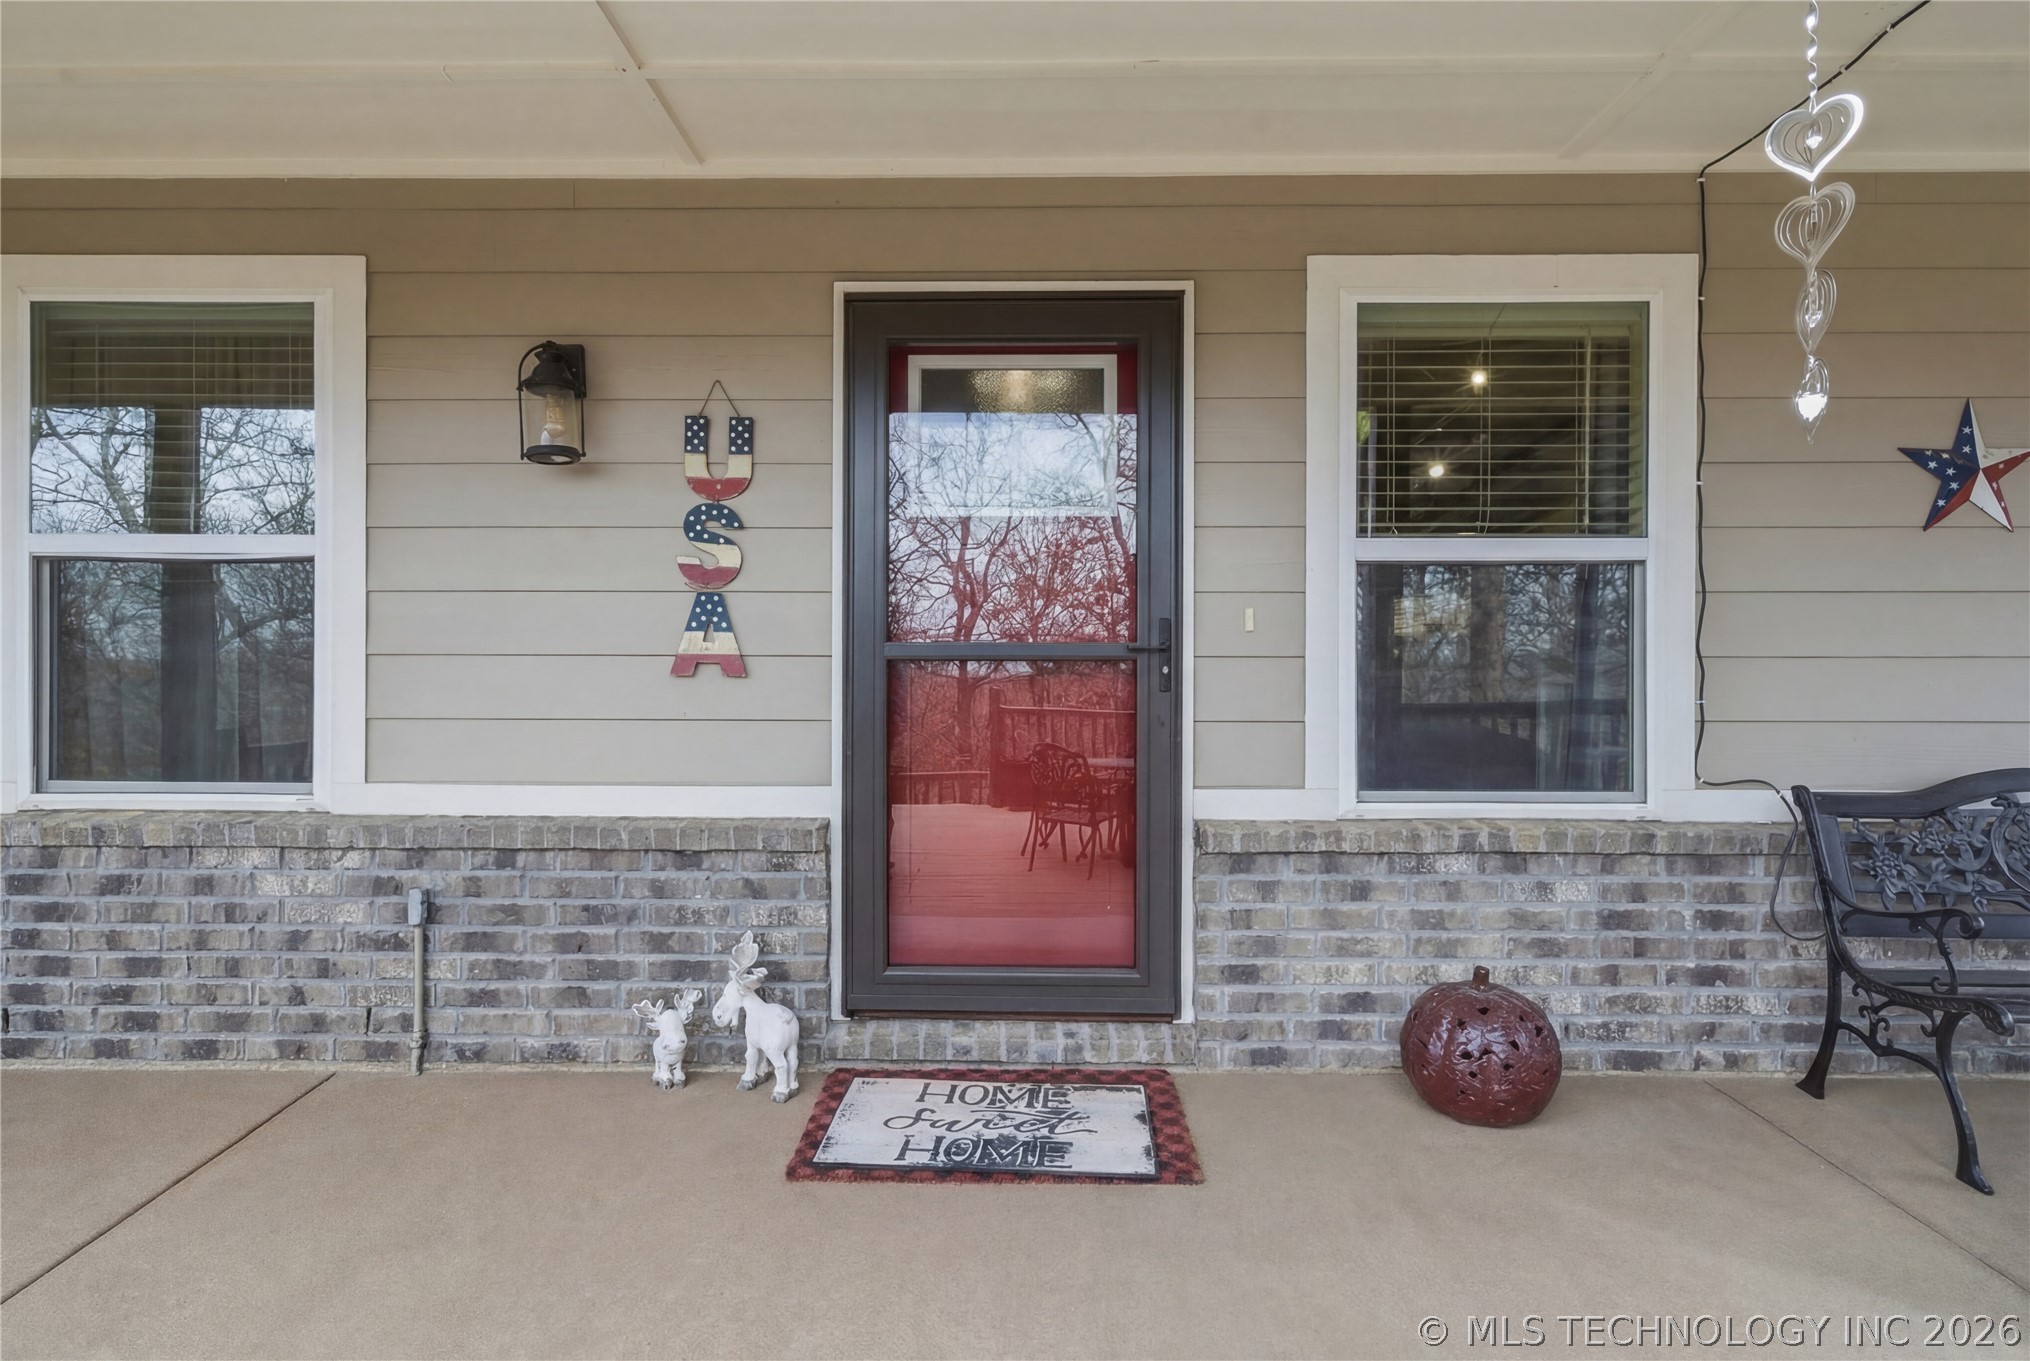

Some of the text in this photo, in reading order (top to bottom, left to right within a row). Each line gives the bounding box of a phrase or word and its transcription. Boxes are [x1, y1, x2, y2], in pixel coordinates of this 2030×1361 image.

[670, 415, 754, 678] USA
[915, 1082, 1074, 1110] HOME
[893, 1135, 1074, 1169] HOME
